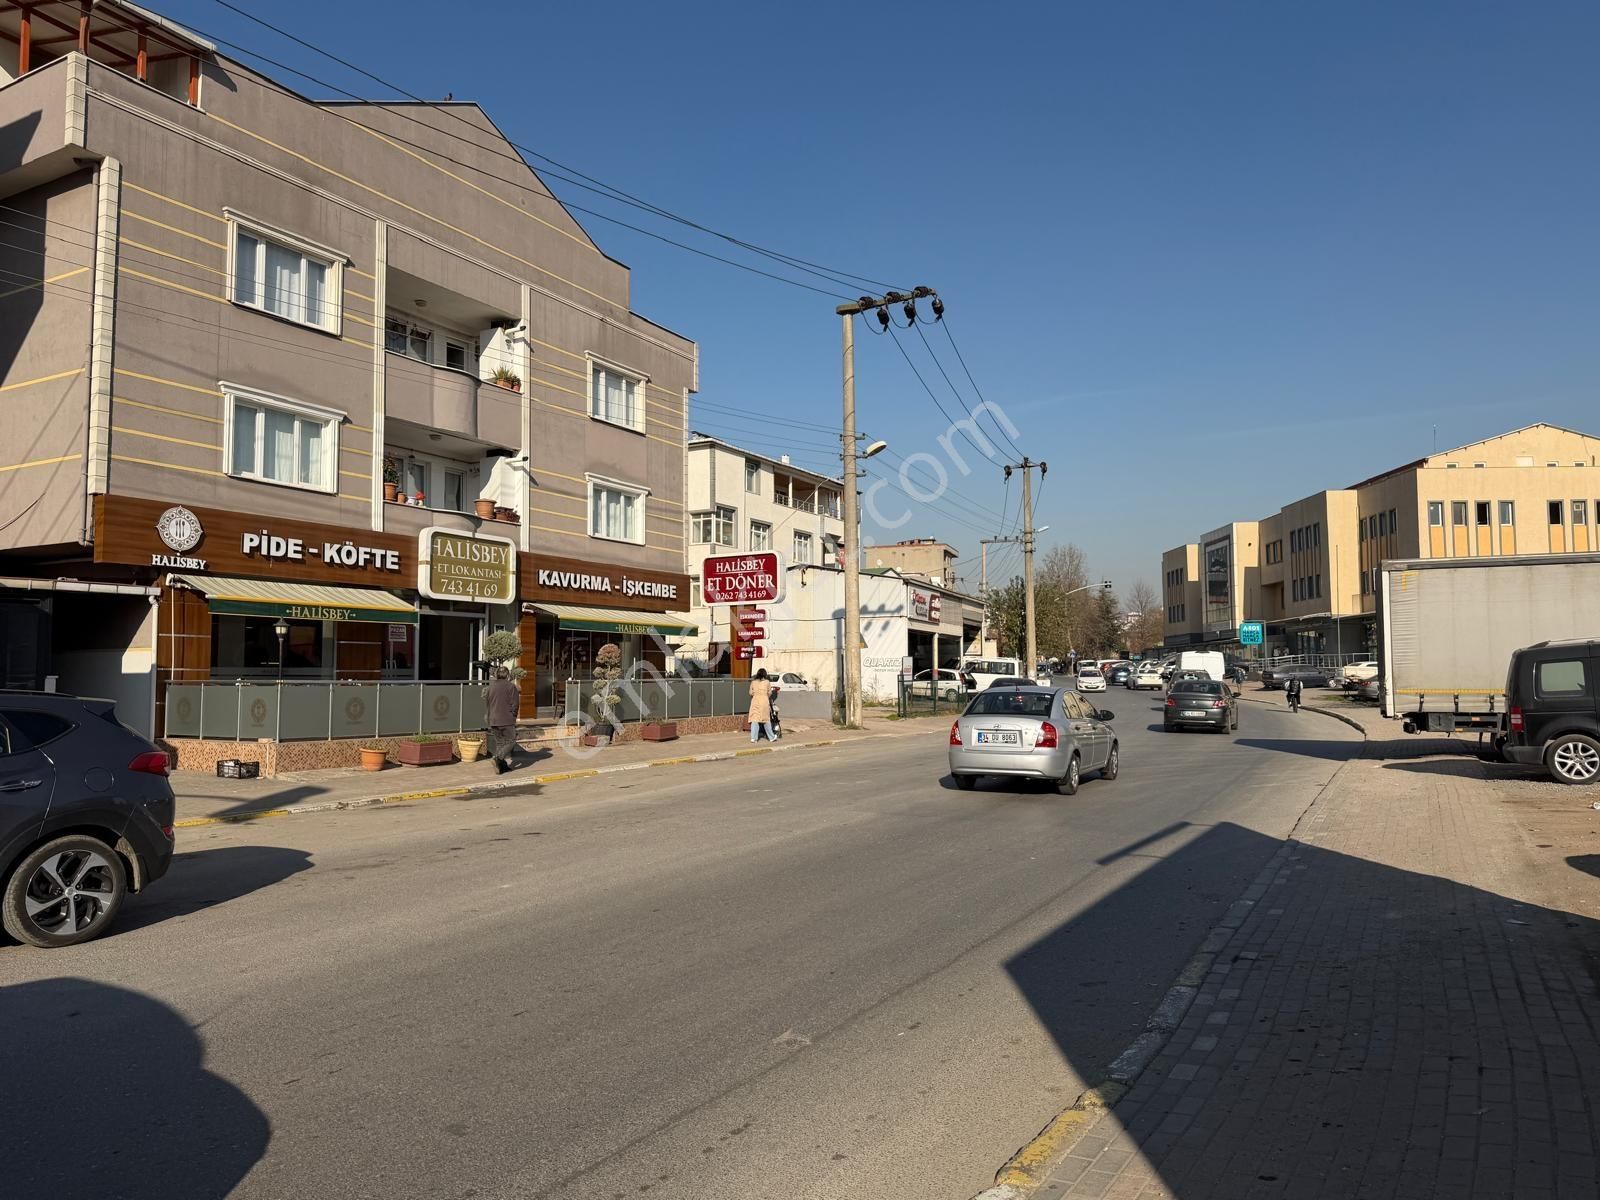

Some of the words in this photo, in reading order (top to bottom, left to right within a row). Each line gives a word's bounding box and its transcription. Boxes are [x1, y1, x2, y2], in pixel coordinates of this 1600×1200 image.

[242, 530, 303, 559] PİDE
[324, 541, 400, 570] KÖFTE
[151, 552, 207, 570] HALİSBEY
[716, 558, 766, 573] HALİSBEY
[437, 564, 449, 574] ET
[451, 564, 502, 579] LOKANTASI
[440, 579, 463, 594] 743
[466, 581, 480, 596] 41
[483, 583, 498, 597] 69
[538, 569, 612, 592] KAVURMA
[622, 575, 677, 599] İŞKEMBE
[707, 577, 722, 592] ET
[725, 573, 776, 591] DÖNER
[716, 592, 733, 600] 0262
[291, 606, 351, 621] HALİSBEY
[863, 656, 902, 668] QUARTZ
